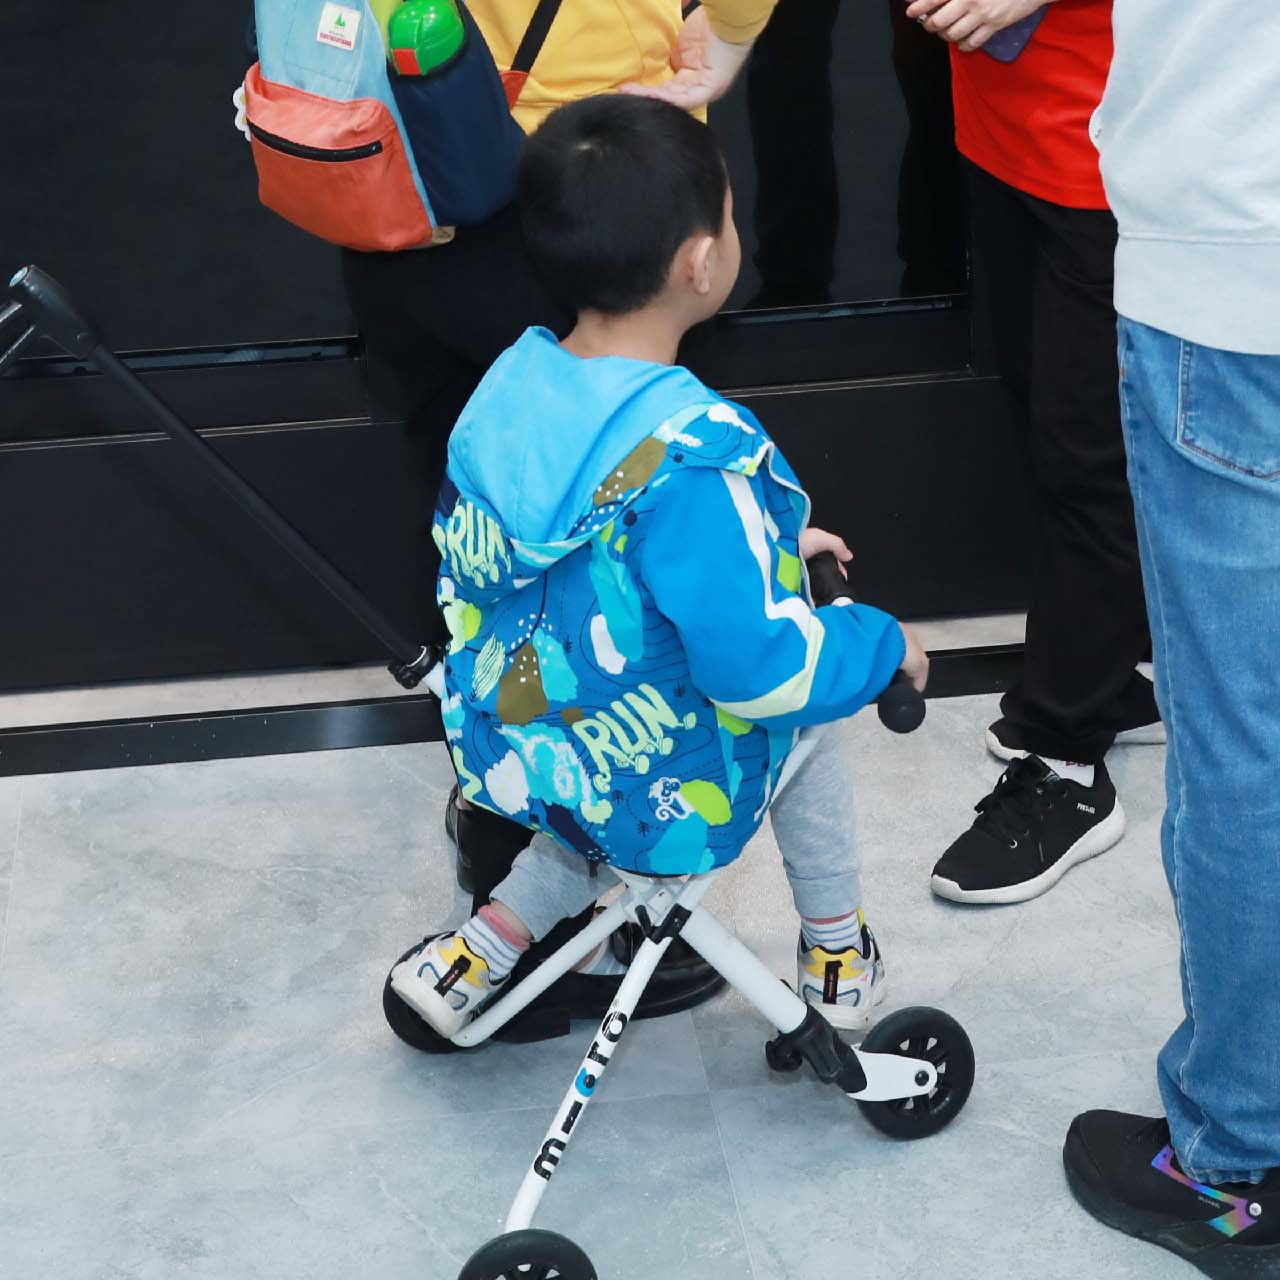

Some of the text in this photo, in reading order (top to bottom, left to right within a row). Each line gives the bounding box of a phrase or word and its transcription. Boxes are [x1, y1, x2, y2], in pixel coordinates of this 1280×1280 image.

[446, 501, 512, 589] RUN
[571, 683, 698, 794] RUN
[533, 1011, 629, 1182] micro
